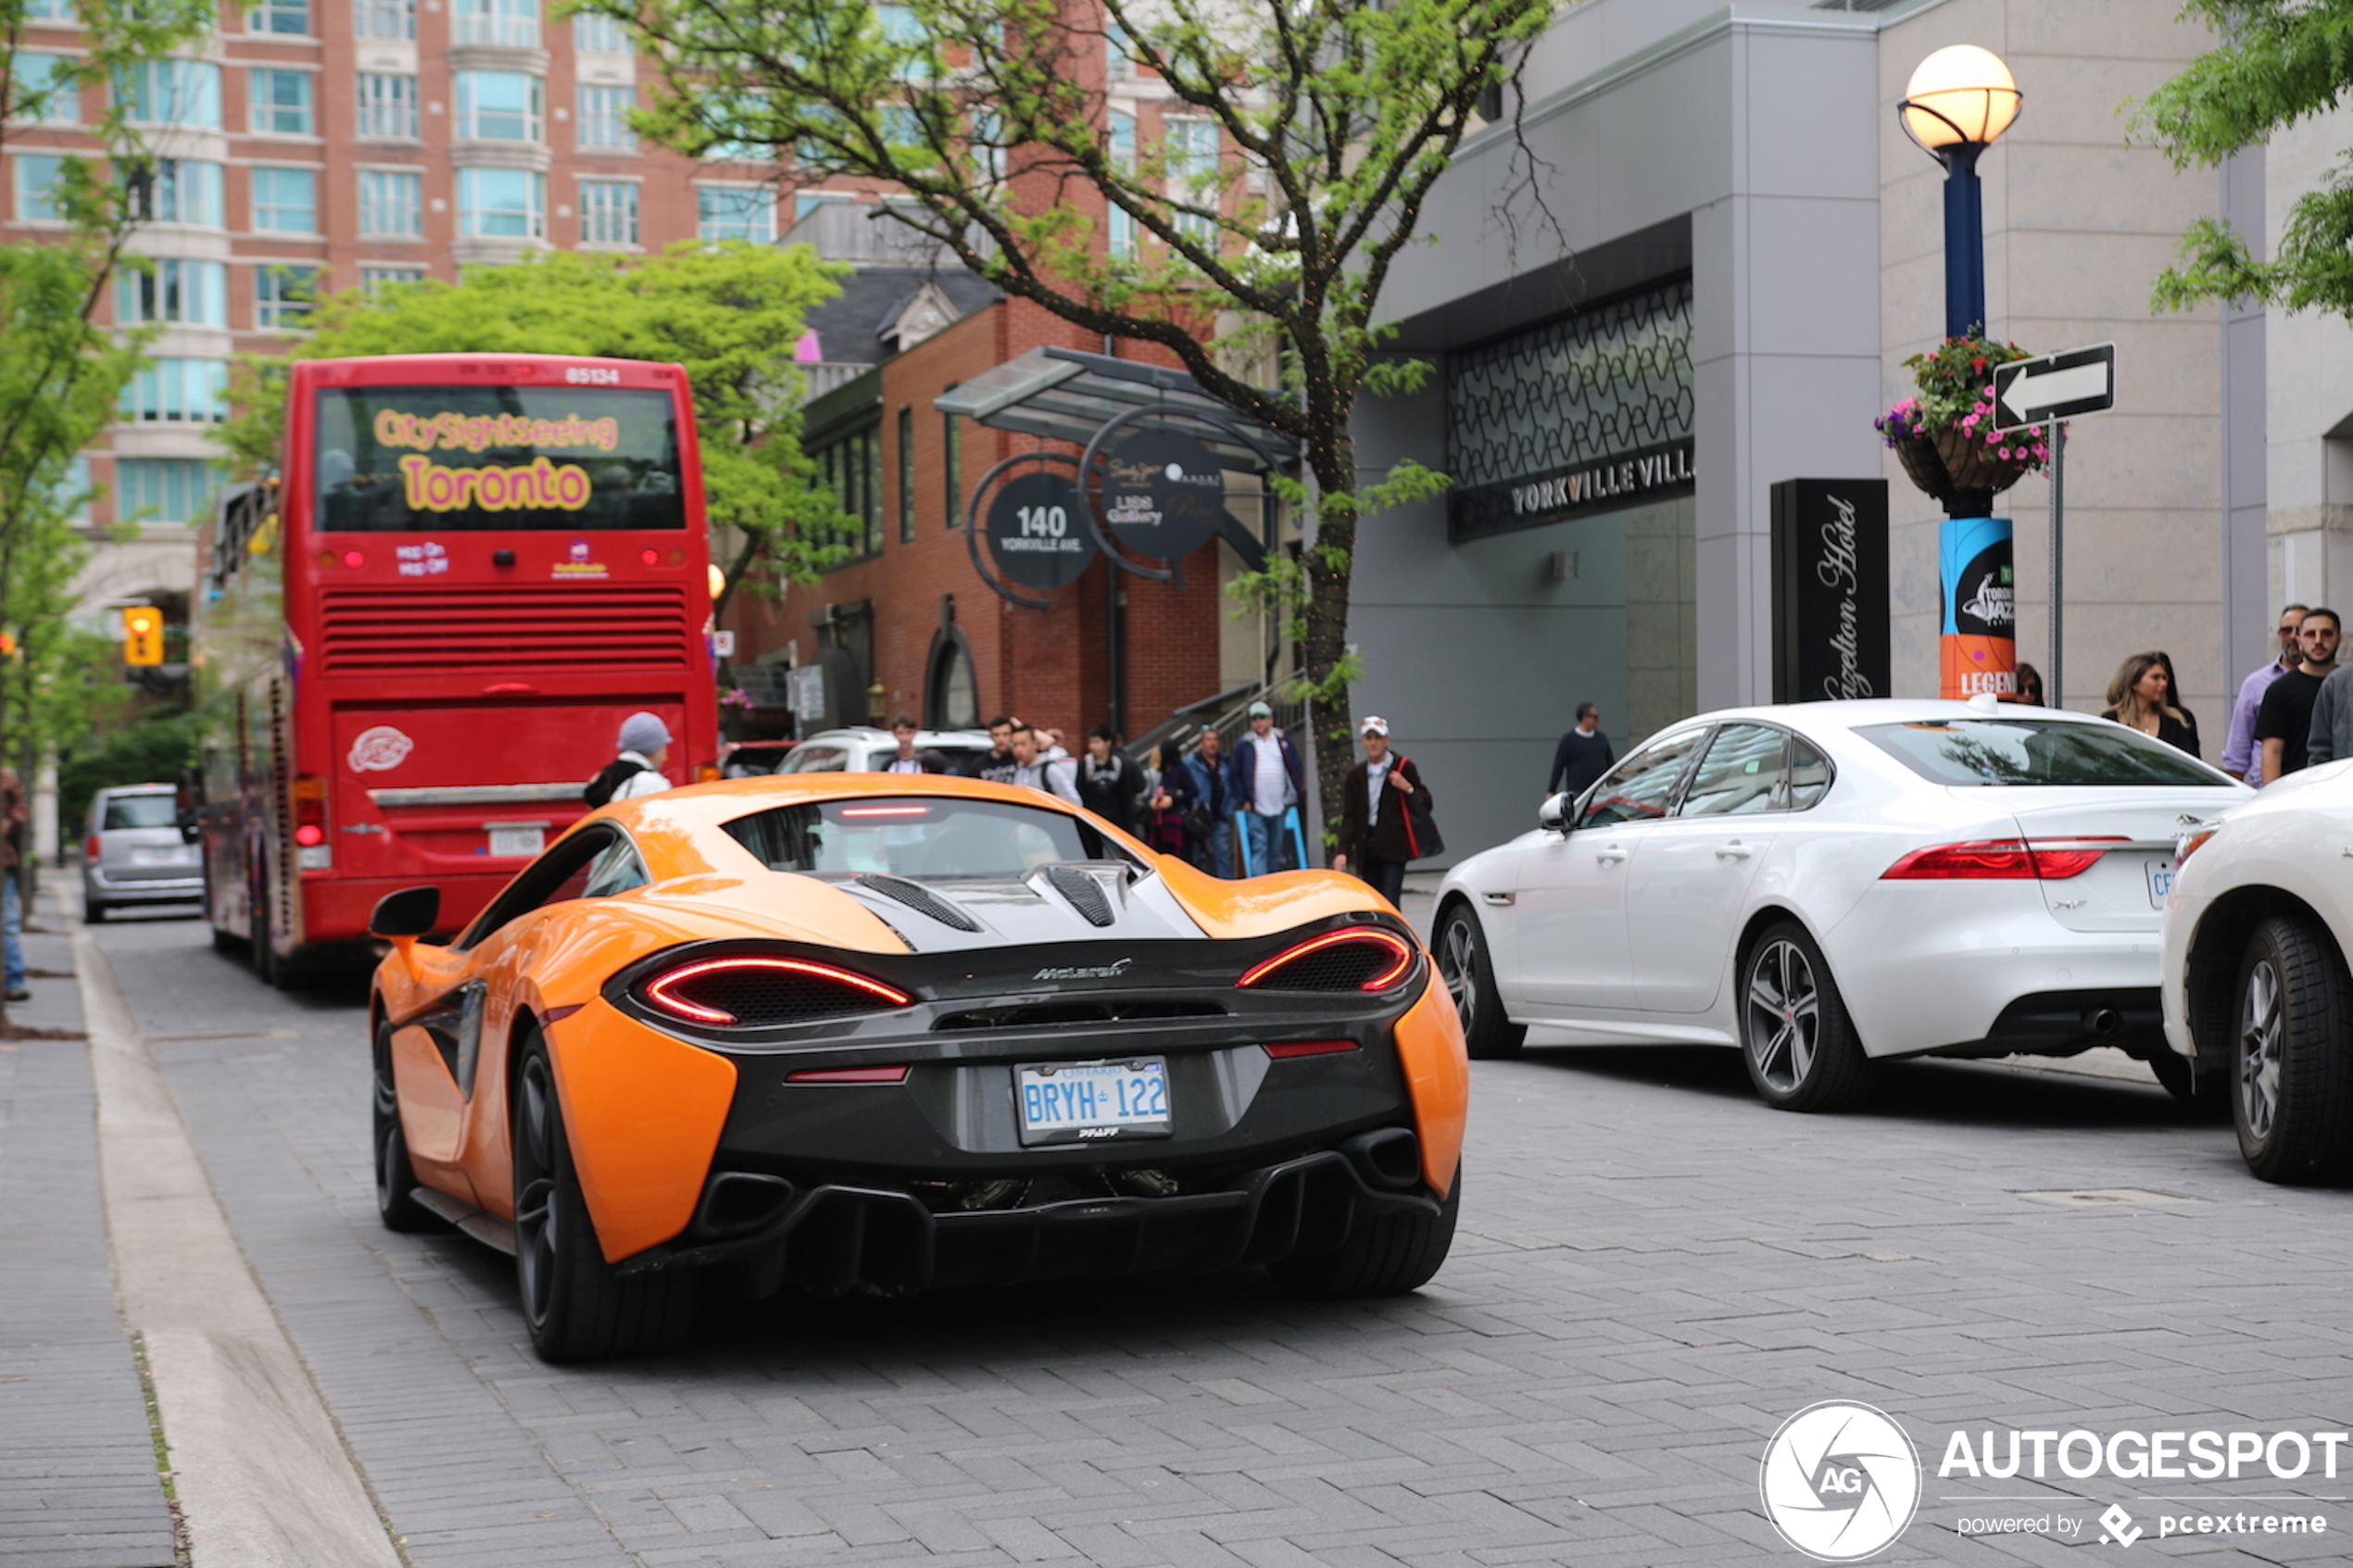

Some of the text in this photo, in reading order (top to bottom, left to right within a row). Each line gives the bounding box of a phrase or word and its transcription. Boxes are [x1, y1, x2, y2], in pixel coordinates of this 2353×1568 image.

[399, 454, 592, 512] Toronto
[1511, 449, 1696, 515] YORKVILLE VILL
[1017, 506, 1066, 537] 140
[1107, 508, 1164, 526] Gallery
[1000, 537, 1058, 552] YORKVILLE
[1817, 494, 1857, 596] Hotel
[2154, 873, 2175, 896] CF
[1032, 966, 1124, 981] McLaren
[1063, 1066, 1122, 1079] ONTARIO
[1024, 1077, 1168, 1122] BRYH 122
[1078, 1127, 1119, 1138] PFAFF
